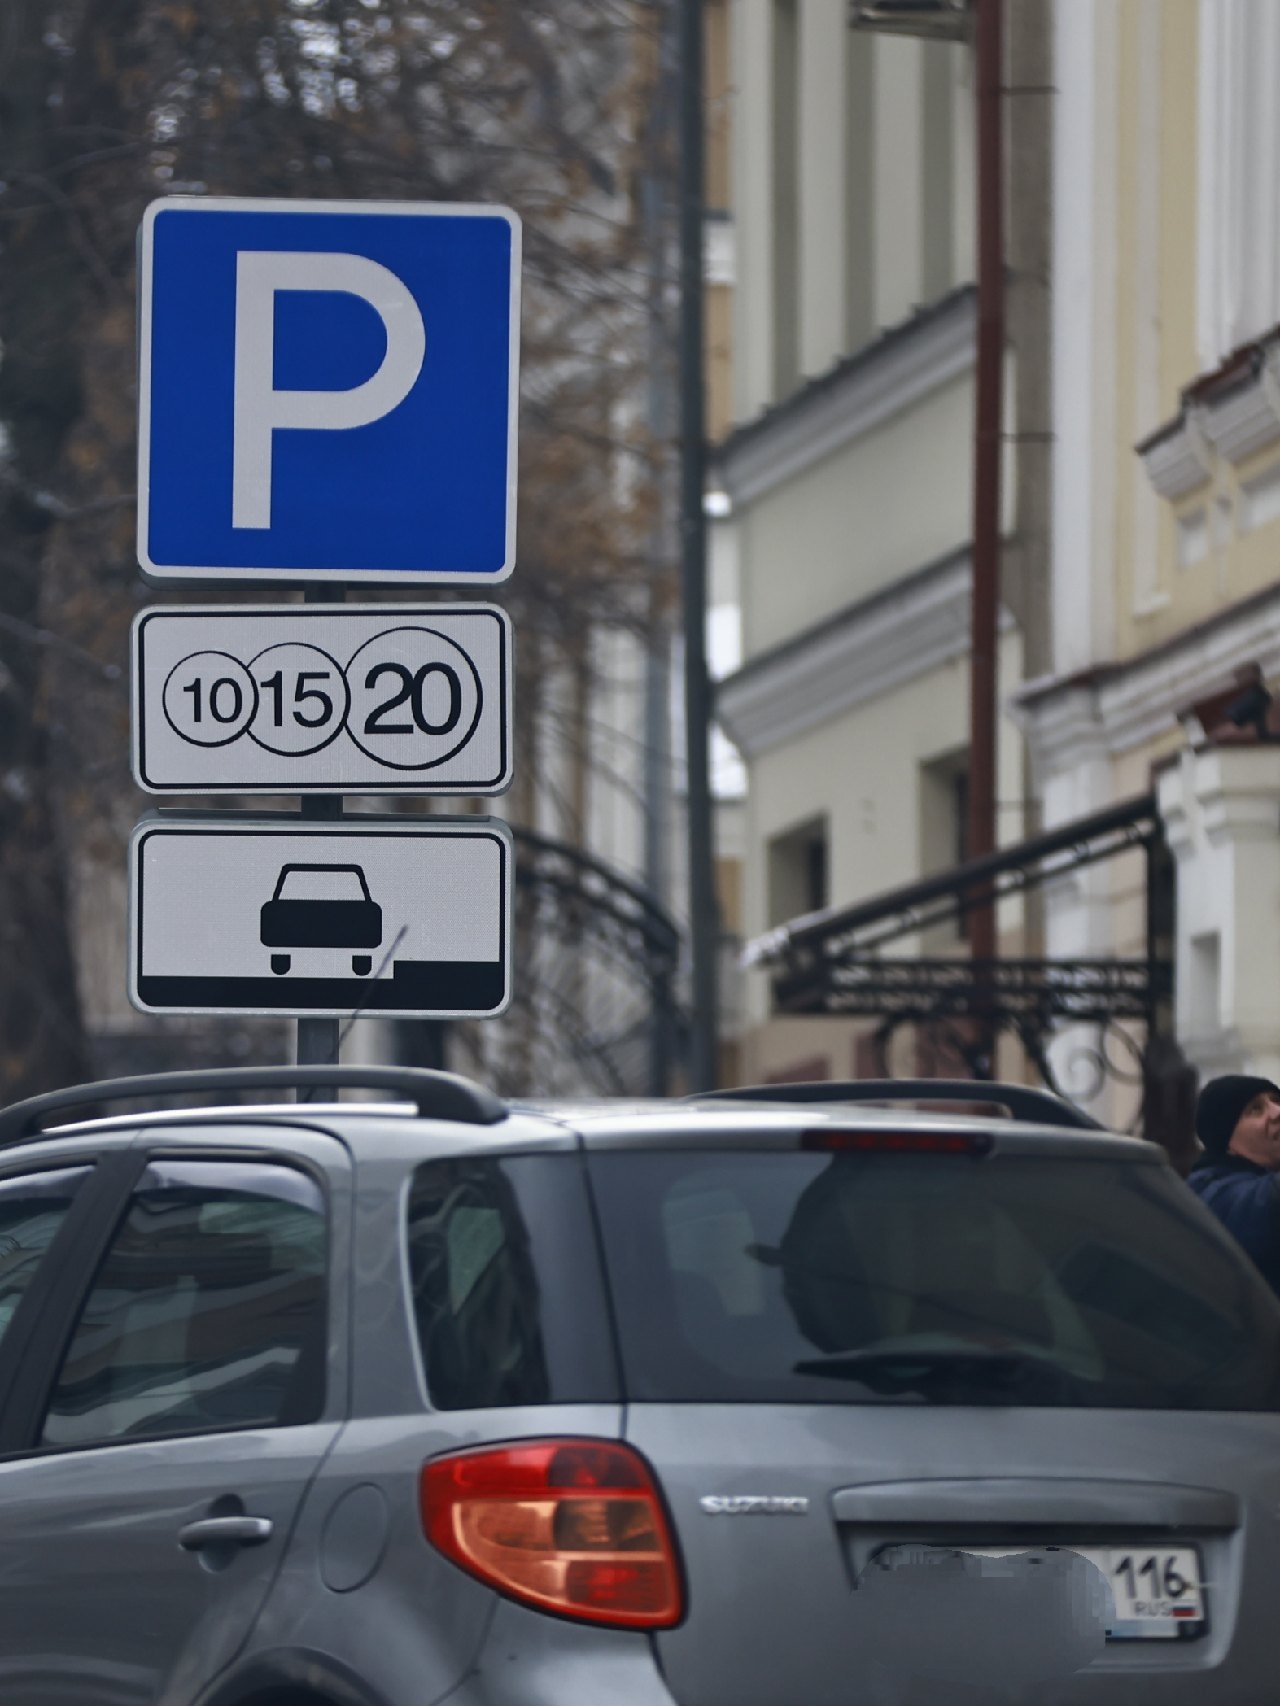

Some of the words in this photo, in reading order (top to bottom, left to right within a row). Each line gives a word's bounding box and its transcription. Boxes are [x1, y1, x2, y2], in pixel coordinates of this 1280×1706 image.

[232, 250, 426, 529] P
[183, 677, 242, 723] 10
[260, 671, 333, 728] 15
[364, 662, 462, 735] 20
[700, 1495, 809, 1514] SUZUKI
[1115, 1556, 1185, 1599] 116
[1134, 1602, 1171, 1617] RUS
